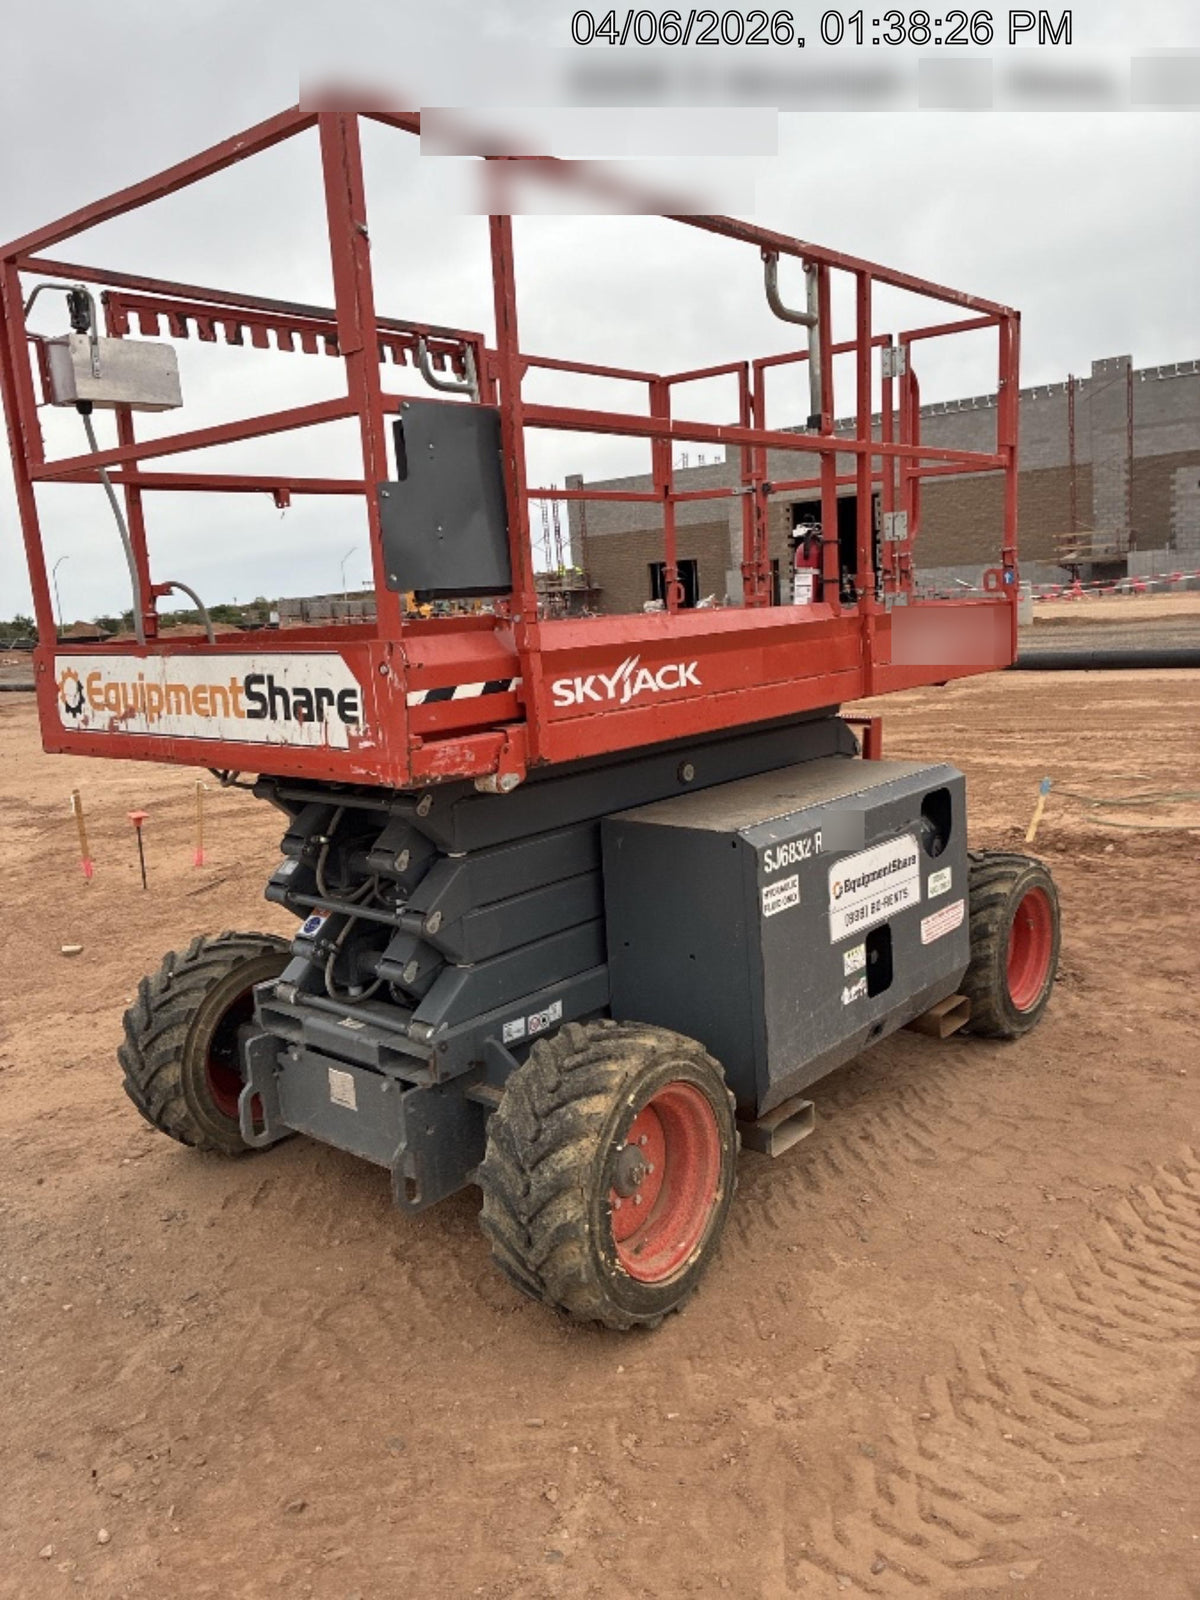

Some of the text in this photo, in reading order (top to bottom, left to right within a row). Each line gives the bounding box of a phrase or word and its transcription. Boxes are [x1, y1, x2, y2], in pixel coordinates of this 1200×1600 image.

[86, 671, 360, 725] EquipmentShare
[551, 654, 702, 707] SKYJACK
[843, 854, 917, 894] EquipmentShare
